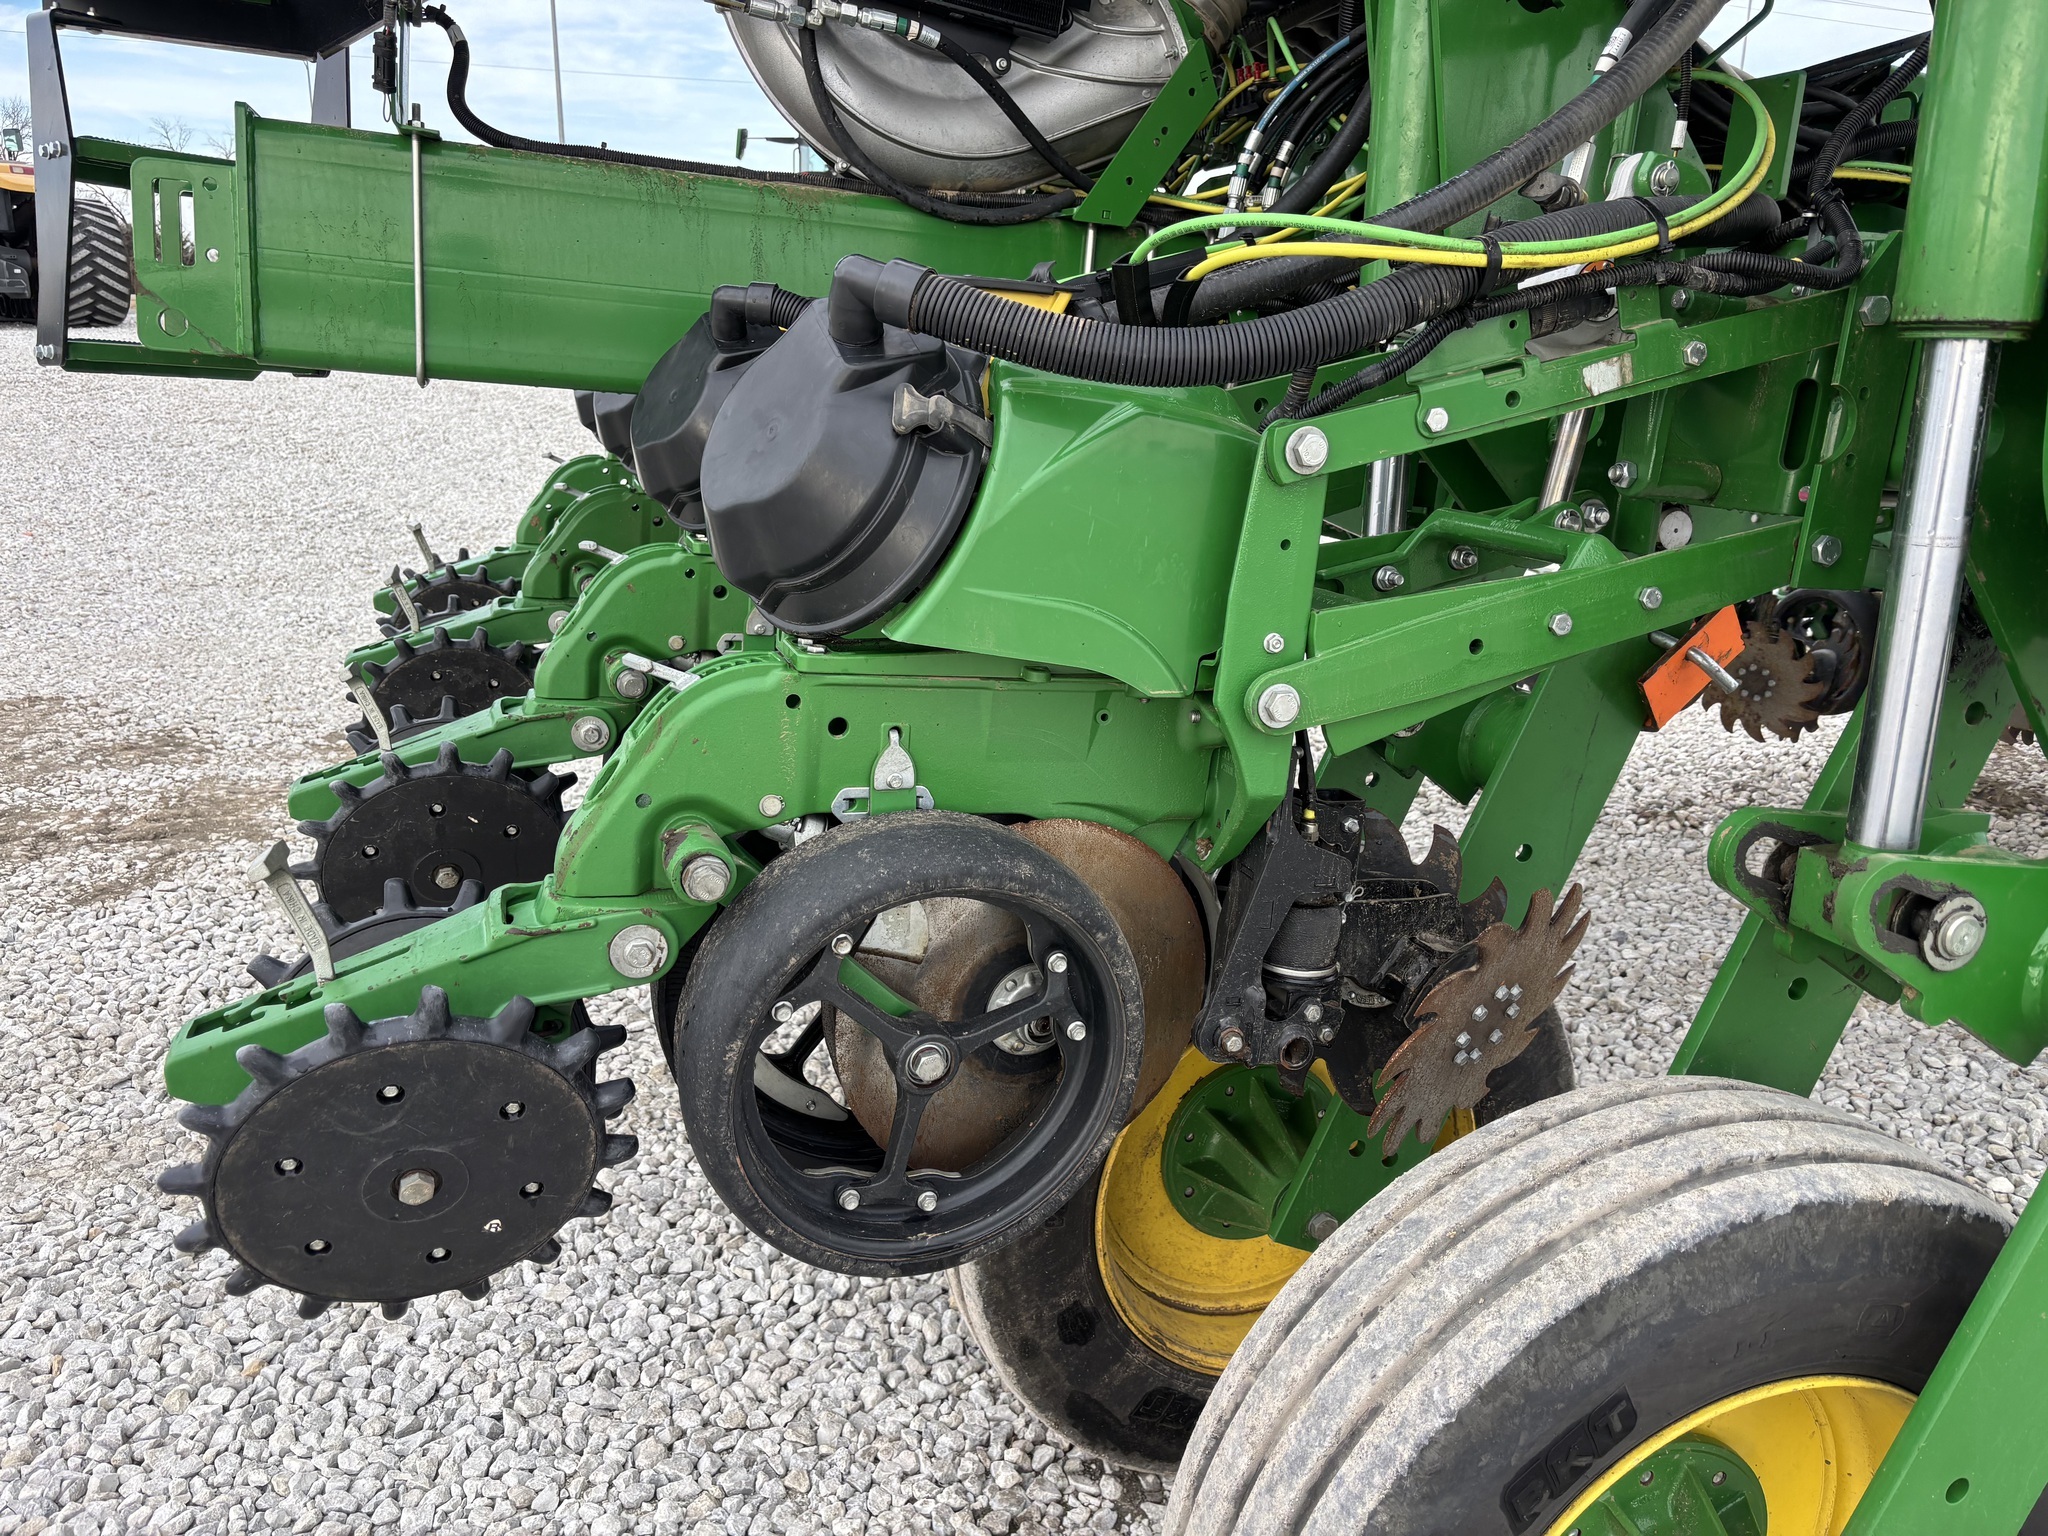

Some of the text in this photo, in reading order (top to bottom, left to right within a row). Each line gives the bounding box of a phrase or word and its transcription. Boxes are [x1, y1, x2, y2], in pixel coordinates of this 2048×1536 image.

[282, 889, 325, 951] MADE IN CHINA
[1508, 1396, 1631, 1526] BKT
